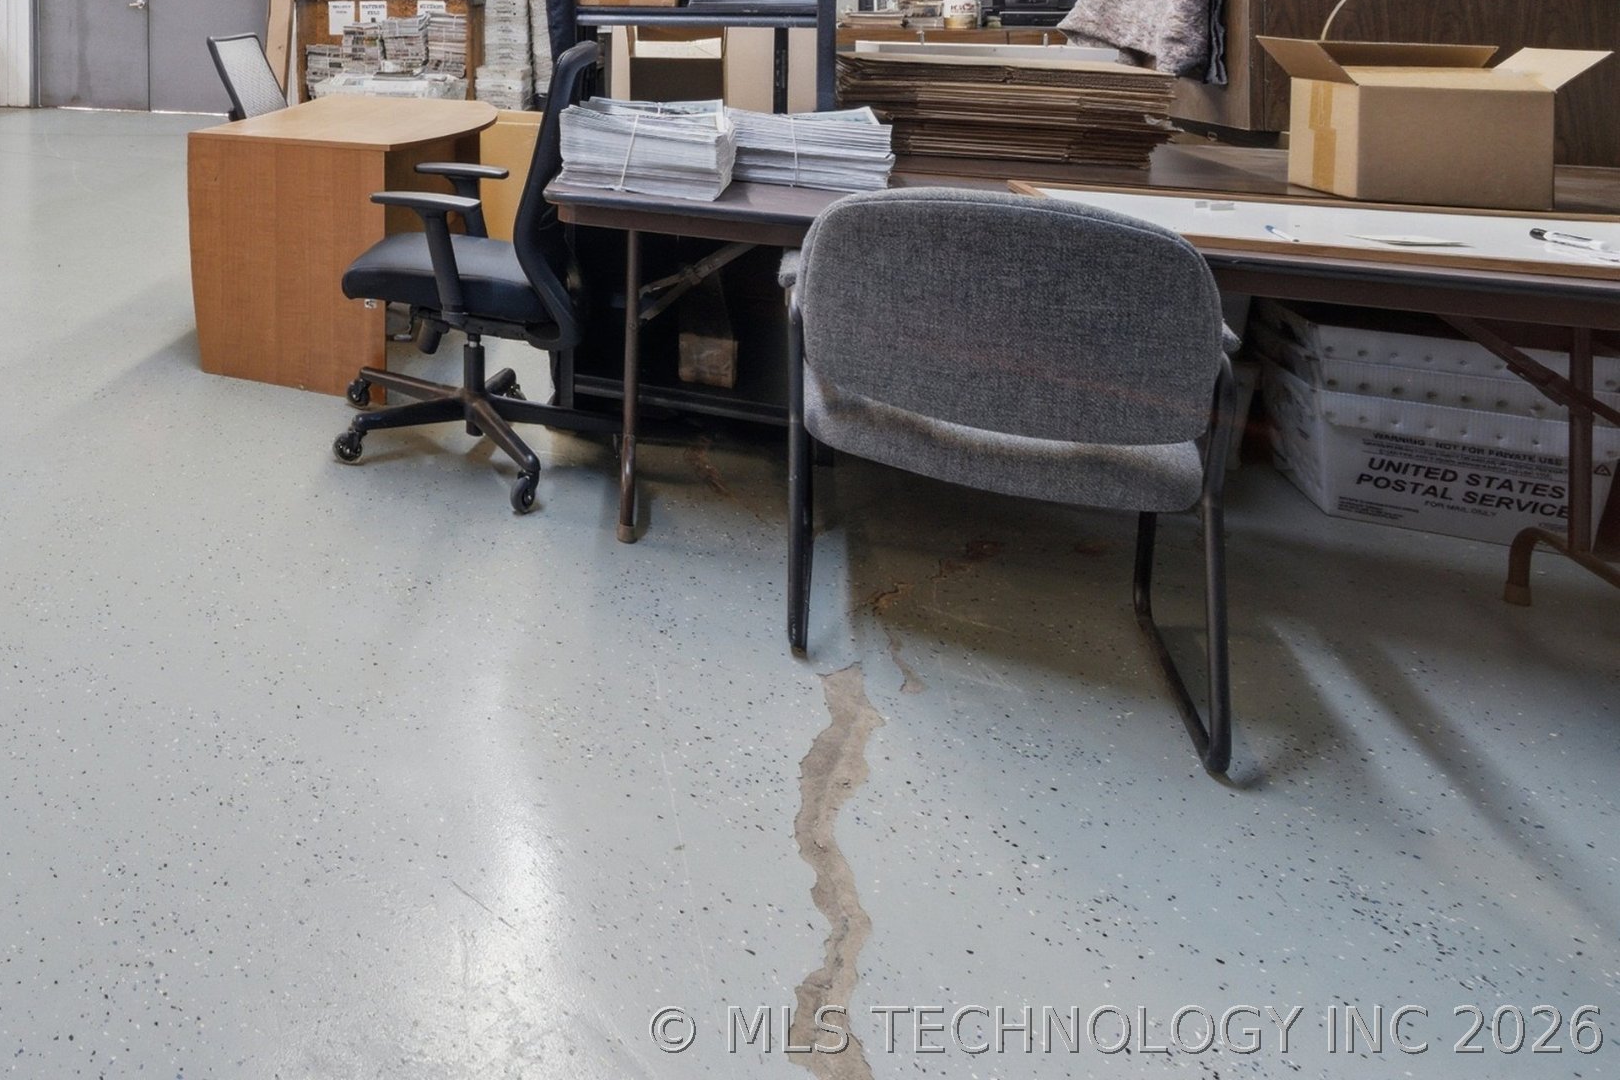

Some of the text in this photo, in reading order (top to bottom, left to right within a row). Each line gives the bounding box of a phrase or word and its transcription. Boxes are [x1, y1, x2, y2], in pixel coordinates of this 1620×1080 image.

[1373, 432, 1425, 447] WARNING
[1436, 438, 1459, 451] NOT
[1461, 444, 1485, 456] FOR
[1488, 448, 1535, 463] PRIVATE
[1538, 456, 1563, 466] USE
[1356, 473, 1569, 520] POSTAL SERVICE
[1368, 457, 1458, 483] UNITED
[1465, 473, 1566, 499] STATES
[1424, 500, 1445, 510] FOR
